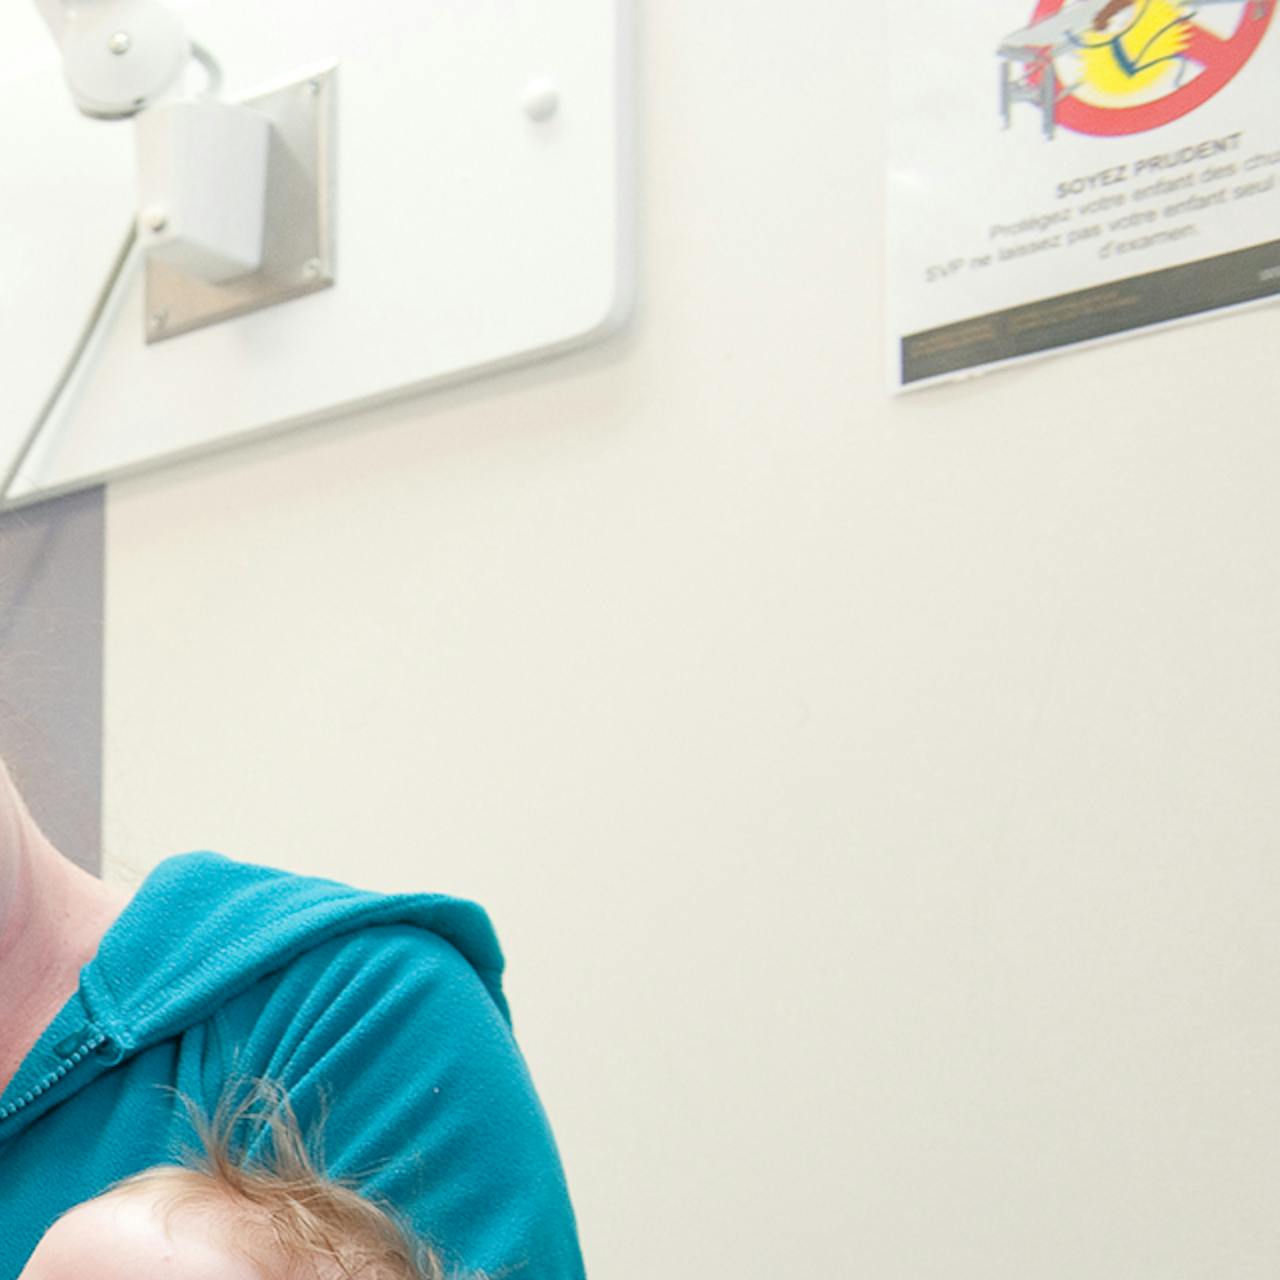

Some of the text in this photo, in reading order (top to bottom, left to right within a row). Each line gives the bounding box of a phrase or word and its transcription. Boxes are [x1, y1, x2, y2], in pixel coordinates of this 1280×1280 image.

[1056, 132, 1243, 199] SOYEZ PRUDENT
[1078, 194, 1126, 216] votre
[1132, 174, 1195, 201] enfant
[1200, 162, 1237, 184] des
[925, 257, 966, 283] SVP
[997, 234, 1062, 262] laissez
[1067, 225, 1102, 246] pas
[1108, 209, 1157, 232] votre
[1163, 188, 1227, 218] enfant
[1233, 173, 1276, 200] seul
